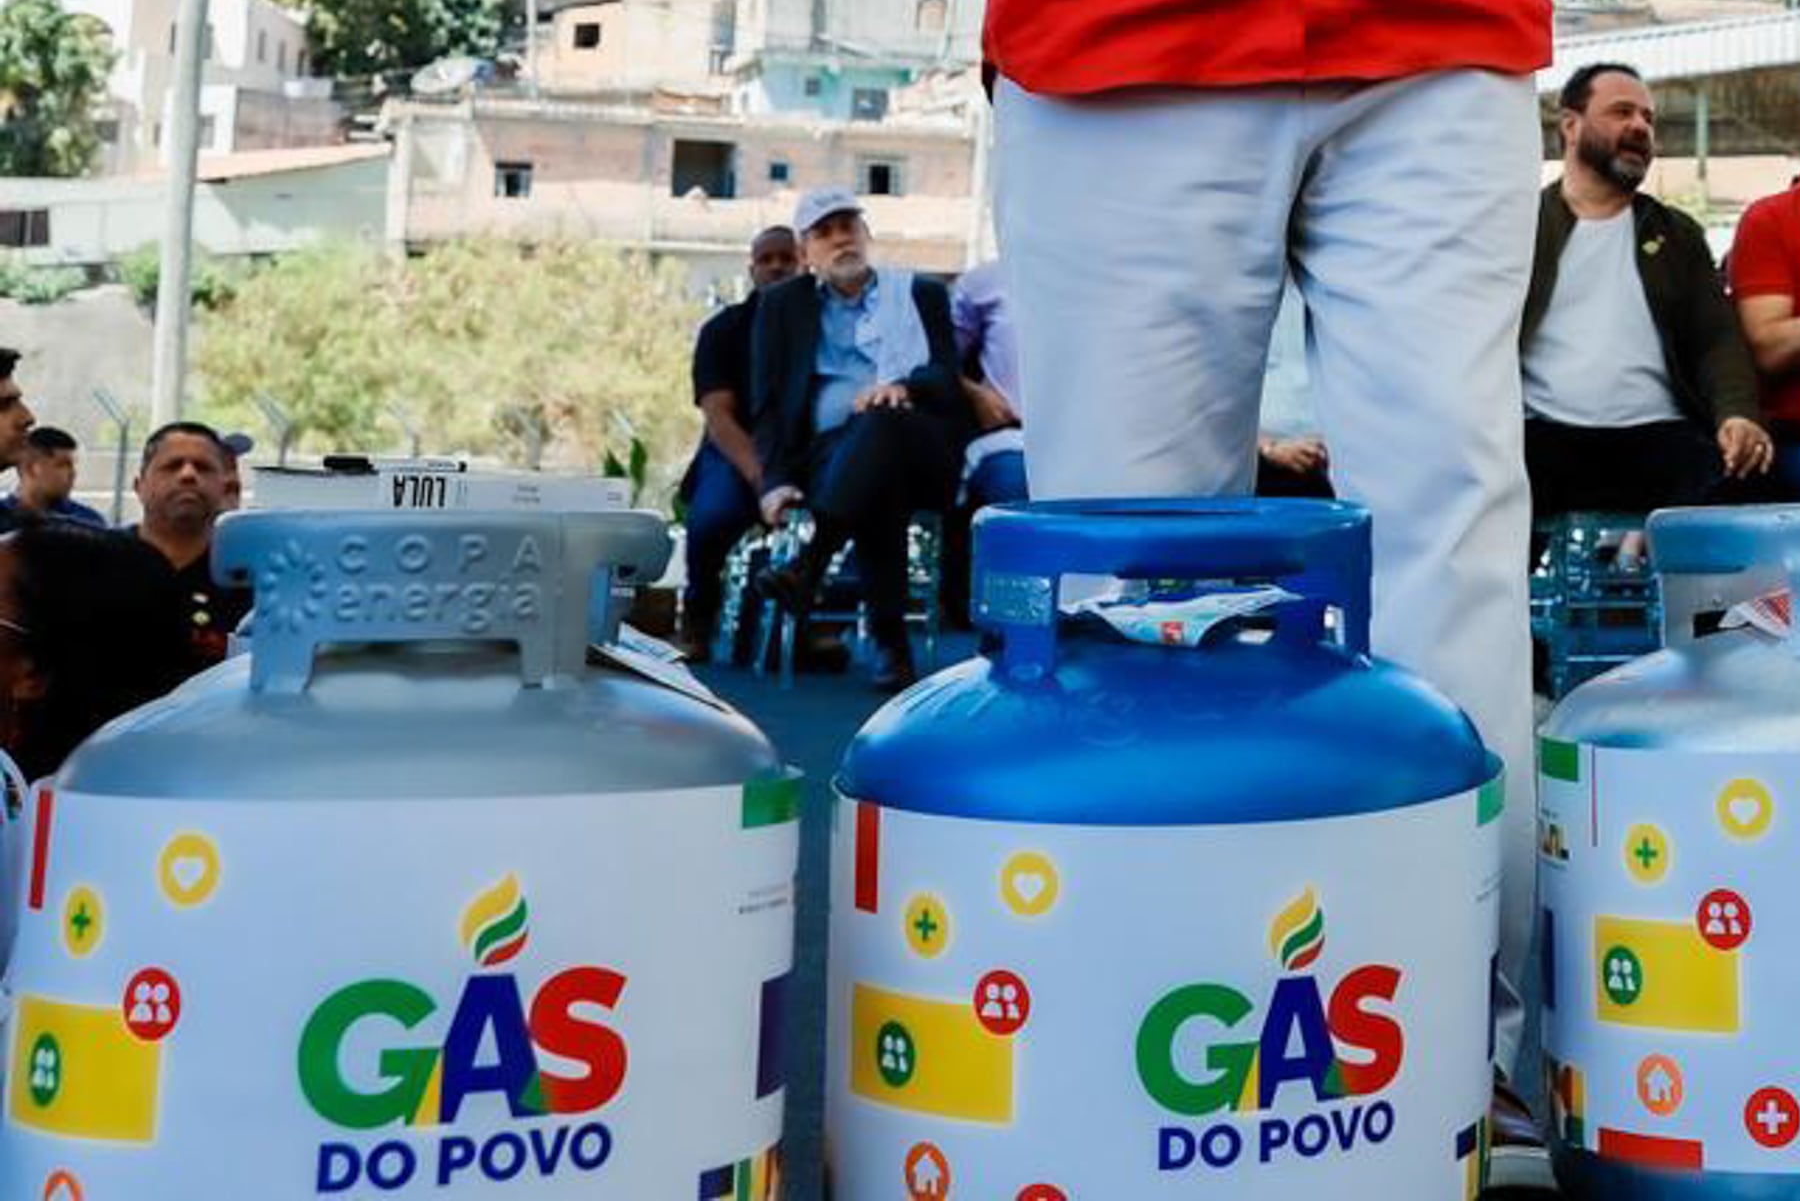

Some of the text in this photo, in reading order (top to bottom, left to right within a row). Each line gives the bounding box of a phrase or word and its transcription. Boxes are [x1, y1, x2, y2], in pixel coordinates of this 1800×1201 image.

[392, 474, 446, 508] LULA
[335, 534, 543, 575] COPA
[334, 579, 542, 634] energia
[315, 1121, 613, 1195] DO POVO
[1158, 1101, 1394, 1171] DO POVO
